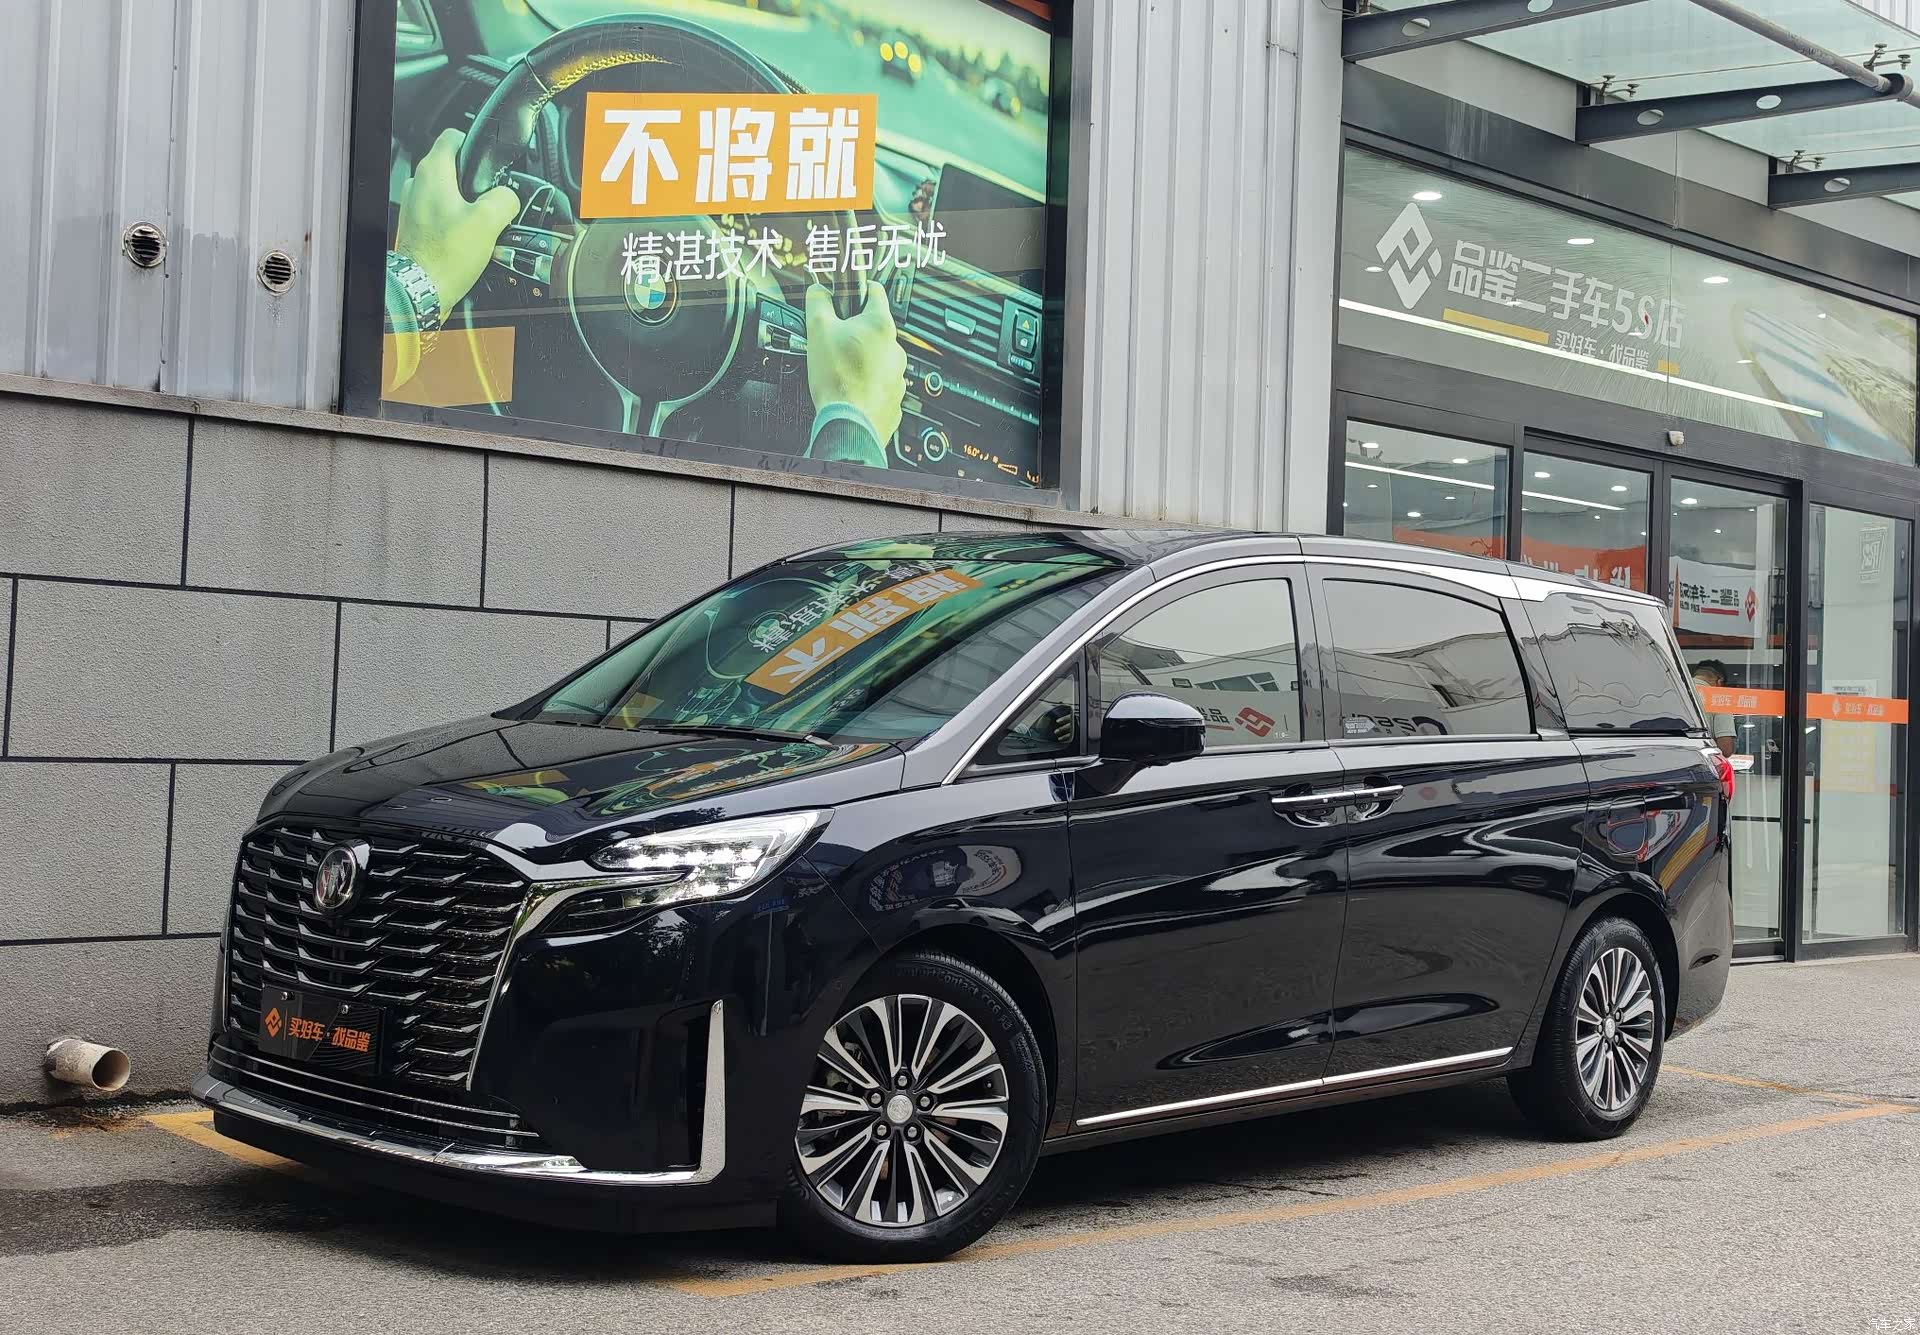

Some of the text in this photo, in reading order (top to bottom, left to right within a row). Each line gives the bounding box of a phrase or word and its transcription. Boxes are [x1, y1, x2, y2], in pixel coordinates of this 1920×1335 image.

[600, 107, 859, 205] 不将就
[621, 219, 947, 285] 精湛技术 售后无忧
[1447, 239, 1687, 349] 品鉴二手车5S店
[288, 1016, 372, 1053] 买好车·找品鉴
